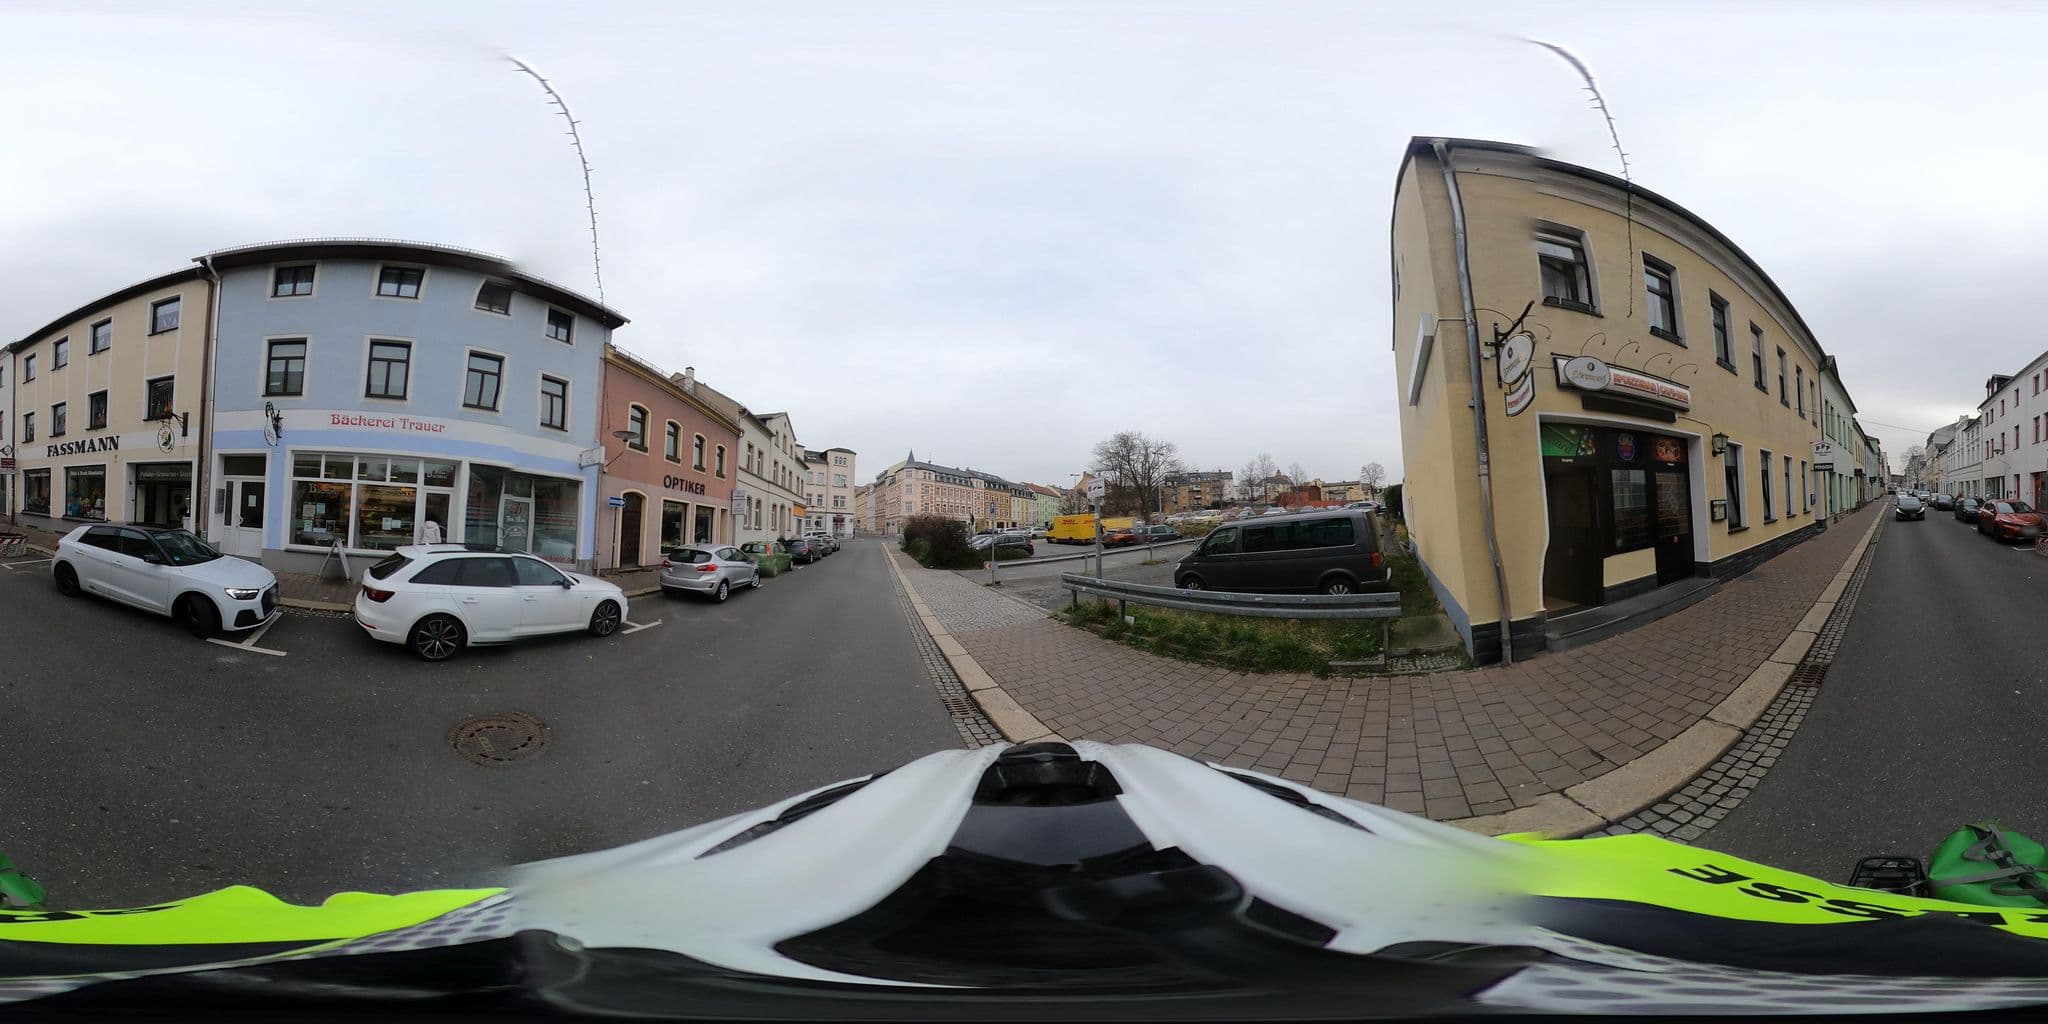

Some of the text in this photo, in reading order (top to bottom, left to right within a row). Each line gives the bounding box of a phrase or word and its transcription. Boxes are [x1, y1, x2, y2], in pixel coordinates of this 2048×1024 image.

[330, 413, 446, 433] Bäckerei Trauer
[47, 435, 120, 457] FASSMANN
[663, 474, 706, 496] OPTIKER
